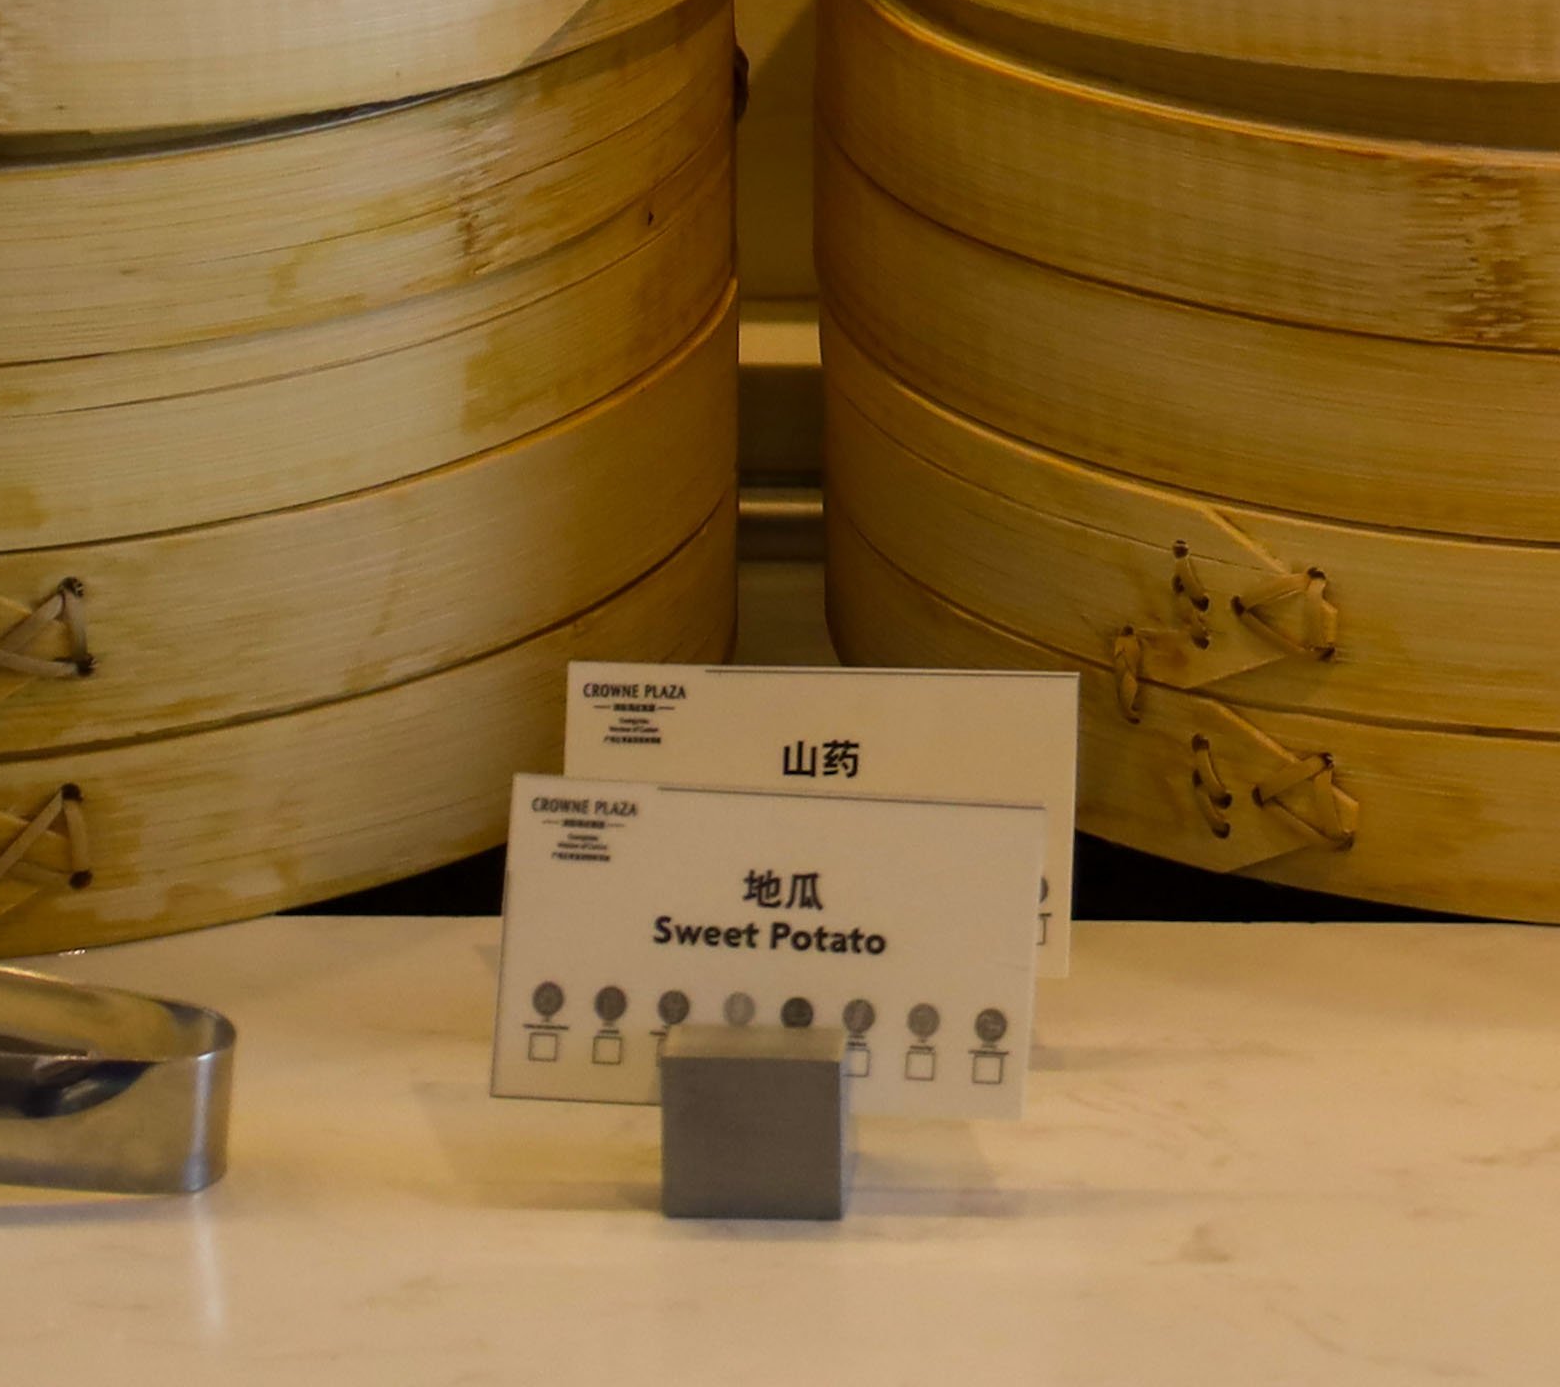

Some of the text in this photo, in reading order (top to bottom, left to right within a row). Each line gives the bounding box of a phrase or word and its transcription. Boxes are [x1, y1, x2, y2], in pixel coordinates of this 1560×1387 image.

[583, 683, 686, 699] CROWNE PLAZA
[782, 739, 860, 778] 山药
[531, 797, 637, 817] CROWNE PLAZA
[742, 869, 823, 911] 地瓜
[653, 915, 887, 955] Sweet Potato
